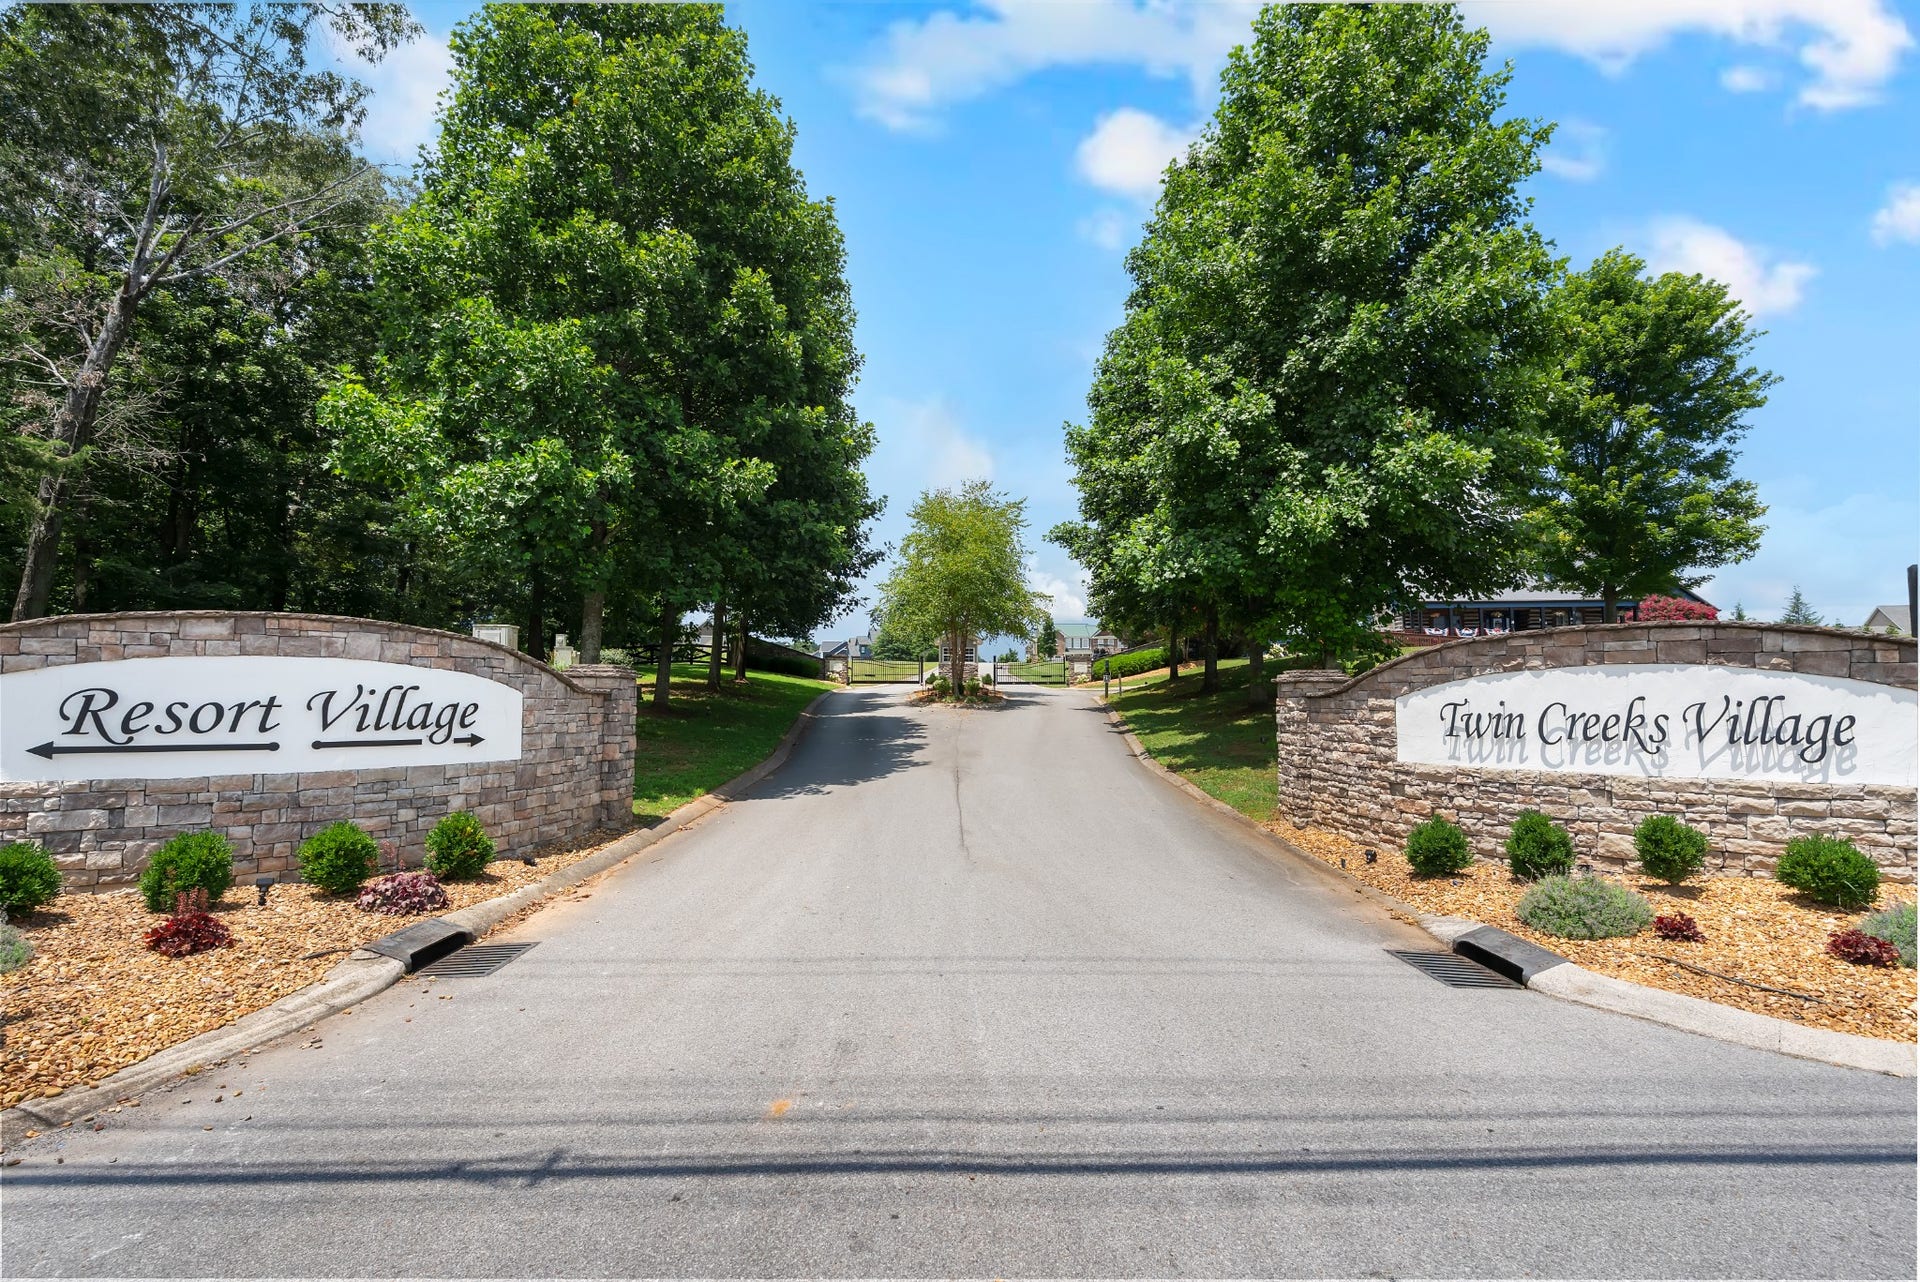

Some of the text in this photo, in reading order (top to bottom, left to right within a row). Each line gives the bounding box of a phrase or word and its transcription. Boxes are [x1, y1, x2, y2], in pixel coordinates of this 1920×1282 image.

[59, 684, 480, 745] Resort Village
[1440, 694, 1857, 763] Twin Creeks Village
